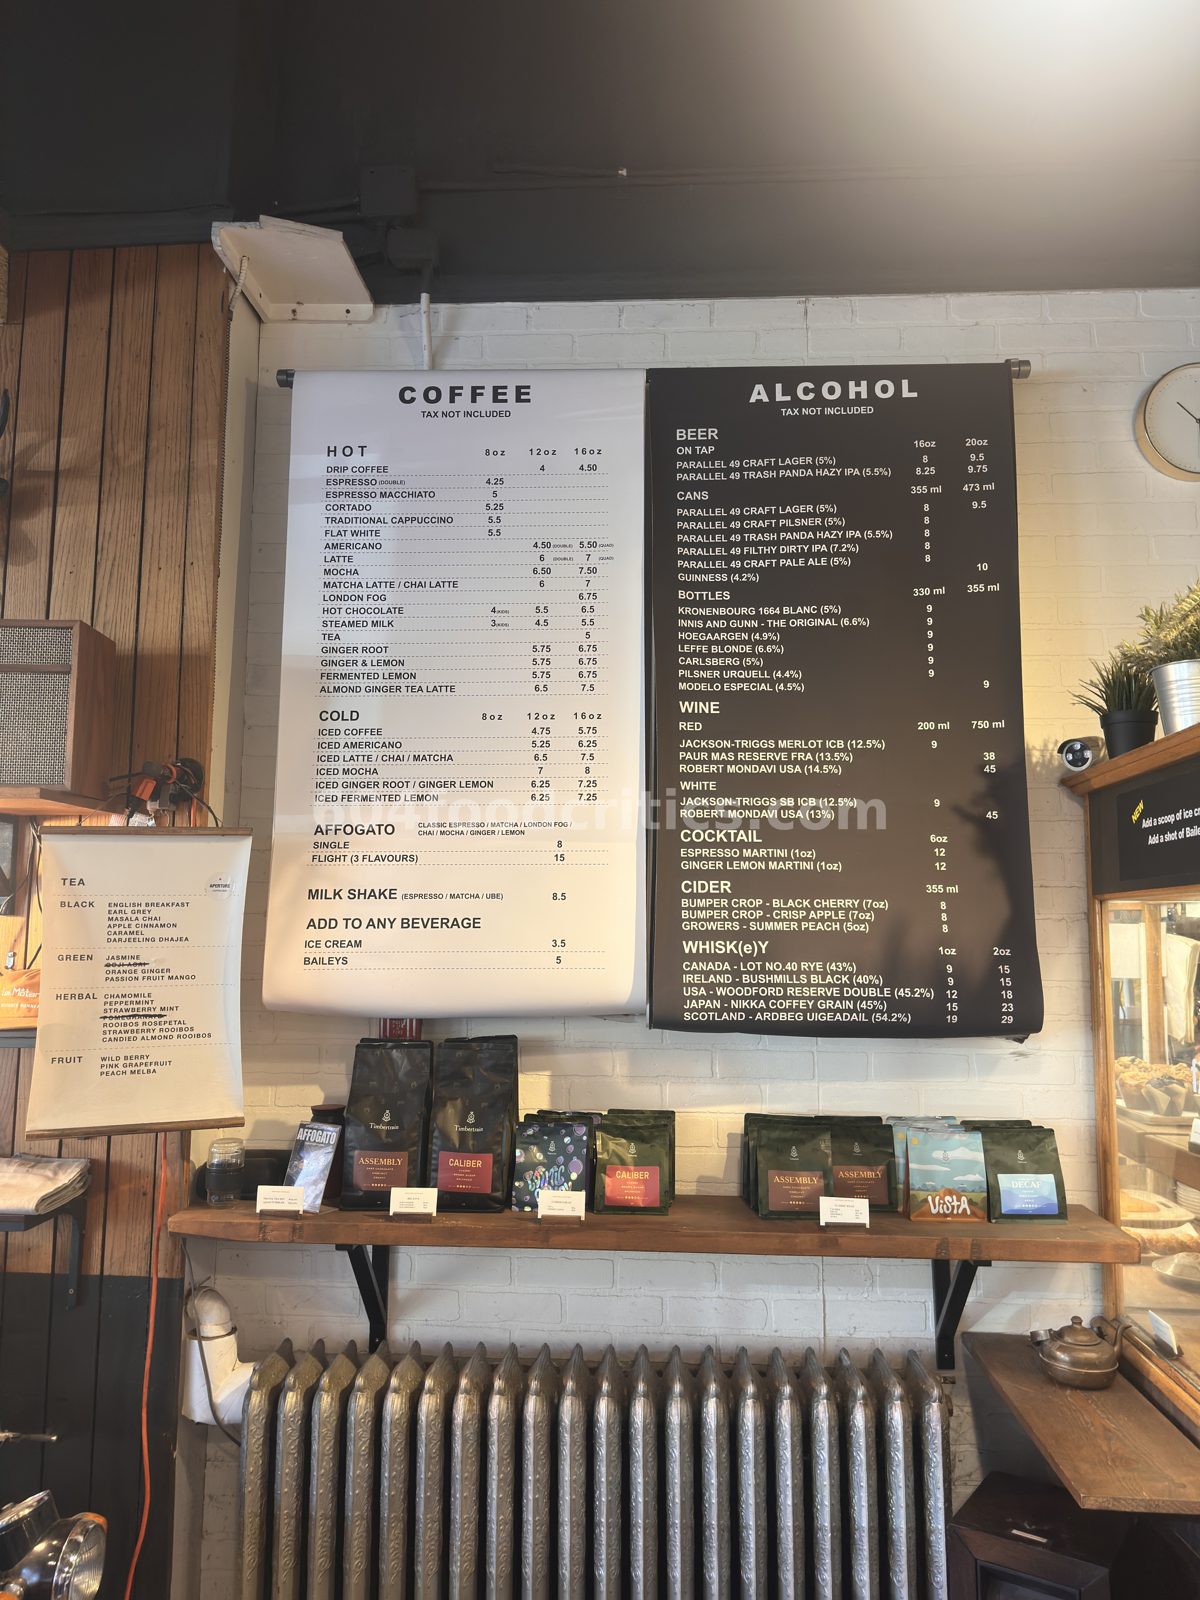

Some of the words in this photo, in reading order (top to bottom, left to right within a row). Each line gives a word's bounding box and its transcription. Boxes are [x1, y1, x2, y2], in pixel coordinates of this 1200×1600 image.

[399, 385, 531, 404] COFFEE
[749, 379, 918, 403] ALCOHOL
[464, 410, 511, 418] INCLUDED
[781, 408, 799, 416] TAX
[825, 406, 874, 415] INCLUDED
[676, 428, 718, 440] BEER
[327, 446, 367, 457] HOT
[529, 448, 556, 456] 12oz
[676, 446, 692, 455] ON
[695, 446, 714, 454] TAP
[914, 440, 936, 448] 16oz
[966, 438, 988, 446] 20oz
[540, 464, 546, 472] 4
[492, 490, 498, 498] 5
[677, 491, 708, 500] CANS
[911, 486, 928, 494] 355
[930, 485, 942, 493] ml
[963, 483, 980, 492] 473
[983, 482, 994, 490] ml
[486, 503, 504, 511] 5.25
[391, 516, 453, 524] CAPPUCCINO
[488, 516, 501, 524] 5.5
[324, 568, 359, 576] MOCHA
[678, 573, 728, 582] GUINNESS
[731, 573, 759, 583] (4.2%)
[977, 563, 988, 571] 10
[323, 594, 363, 602] LONDON
[579, 592, 597, 600] 6.75
[678, 590, 730, 600] BOTTLES
[678, 632, 748, 640] HOEGAARGEN
[751, 632, 780, 642] (4.9%)
[927, 630, 933, 638] 9
[321, 646, 358, 654] GINGER
[362, 646, 389, 654] ROOT
[578, 644, 597, 652] 6.75
[678, 644, 708, 653] LEFFE
[712, 645, 752, 653] BLONDE
[755, 645, 784, 654] (6.6%)
[928, 643, 934, 651] 9
[679, 657, 740, 665] CARLSBERG
[743, 658, 763, 667] (5%)
[928, 656, 934, 664] 9
[679, 701, 720, 714] WINE
[319, 710, 359, 721] COLD
[679, 722, 702, 730] RED
[918, 722, 935, 730] 200
[938, 721, 950, 730] ml
[971, 720, 989, 729] 750
[992, 720, 1005, 728] ml
[318, 728, 341, 736] ICED
[344, 728, 382, 736] COFFEE
[532, 727, 550, 735] 4.75
[343, 741, 402, 749] AMERICANO
[532, 740, 550, 748] 5.25
[578, 740, 597, 748] 6.25
[680, 781, 716, 790] WHITE
[1132, 800, 1144, 824] NEW
[1142, 817, 1152, 828] Add
[1153, 818, 1157, 826] a
[1158, 814, 1174, 824] scoop
[1176, 810, 1182, 820] of
[1183, 809, 1193, 819] ice
[314, 824, 395, 836] AFFOGATO
[680, 830, 762, 842] COCKTAIL
[930, 834, 948, 842] 6oz
[1148, 834, 1159, 845] Add
[1165, 831, 1177, 842] shot
[1178, 828, 1184, 839] of
[350, 855, 359, 864] (3
[362, 854, 418, 864] FLAVOURS)
[554, 854, 565, 862] 15
[681, 848, 739, 857] ESPRESSO
[743, 849, 787, 857] MARTINI
[791, 849, 816, 860] (1oz)
[934, 848, 946, 856] 12
[60, 878, 85, 886] TEA
[681, 880, 731, 893] CIDER
[926, 884, 944, 893] 355
[946, 884, 958, 893] ml
[308, 889, 343, 900] MILK
[347, 888, 397, 900] SHAKE
[552, 892, 566, 900] 8.5
[306, 918, 338, 929] ADD
[342, 918, 362, 929] TO
[366, 918, 397, 929] ANY
[401, 918, 481, 929] BEVERAGE
[304, 940, 321, 948] ICE
[325, 940, 362, 948] CREAM
[552, 939, 566, 948] 3.5
[682, 941, 768, 957] WHISK(e)Y
[939, 946, 956, 955] 1oz
[993, 947, 1011, 956] 2oz
[304, 956, 348, 965] BAILEYS
[556, 956, 562, 964] 5
[51, 1056, 83, 1064] FRUIT
[297, 1128, 337, 1144] AFFOGATO
[358, 1157, 403, 1166] ASSEMBLY
[449, 1158, 482, 1168] CALIBER
[616, 1171, 650, 1179] CALIBER
[838, 1169, 882, 1178] ASSEMBLY
[774, 1175, 818, 1184] ASSEMBLY
